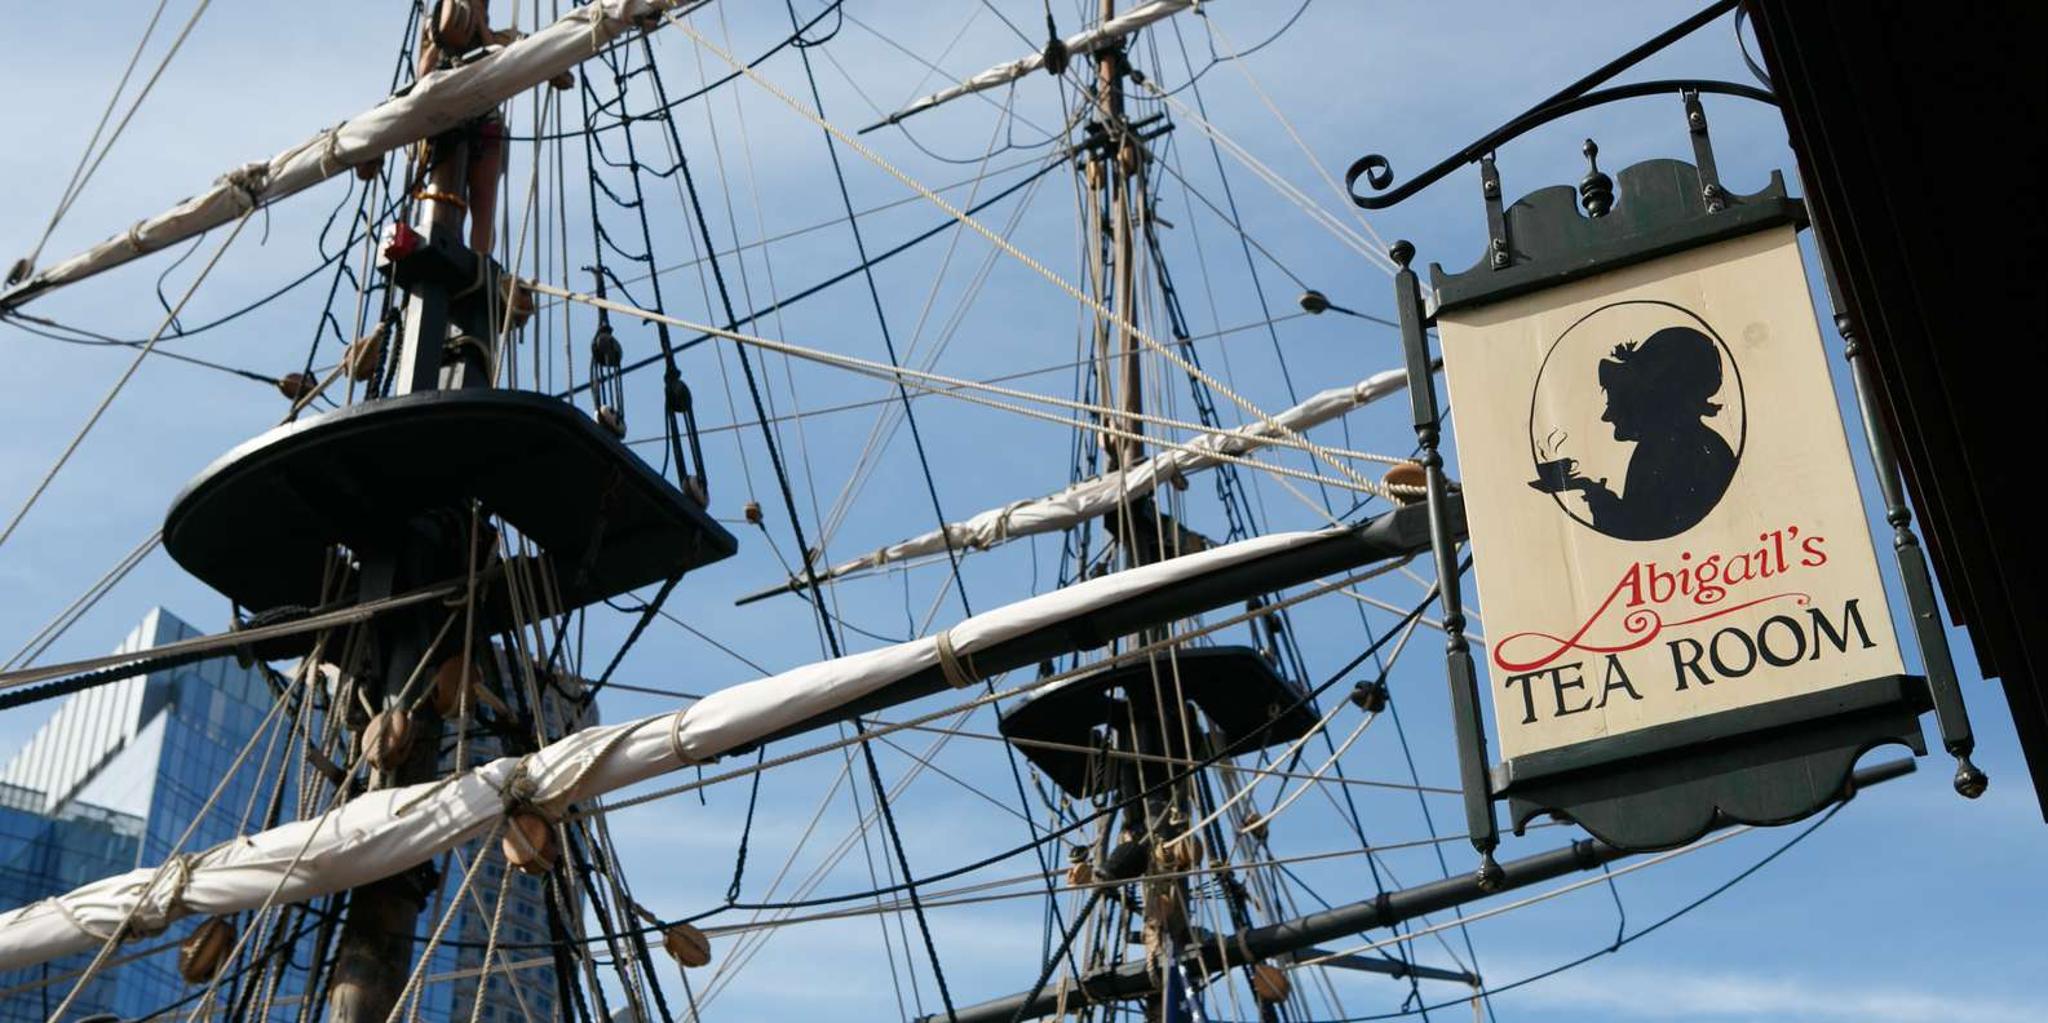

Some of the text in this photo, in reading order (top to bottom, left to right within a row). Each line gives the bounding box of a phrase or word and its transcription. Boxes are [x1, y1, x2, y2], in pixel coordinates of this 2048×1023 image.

[1570, 526, 1828, 645] Abigail's
[1505, 599, 1877, 724] TEA ROOM
